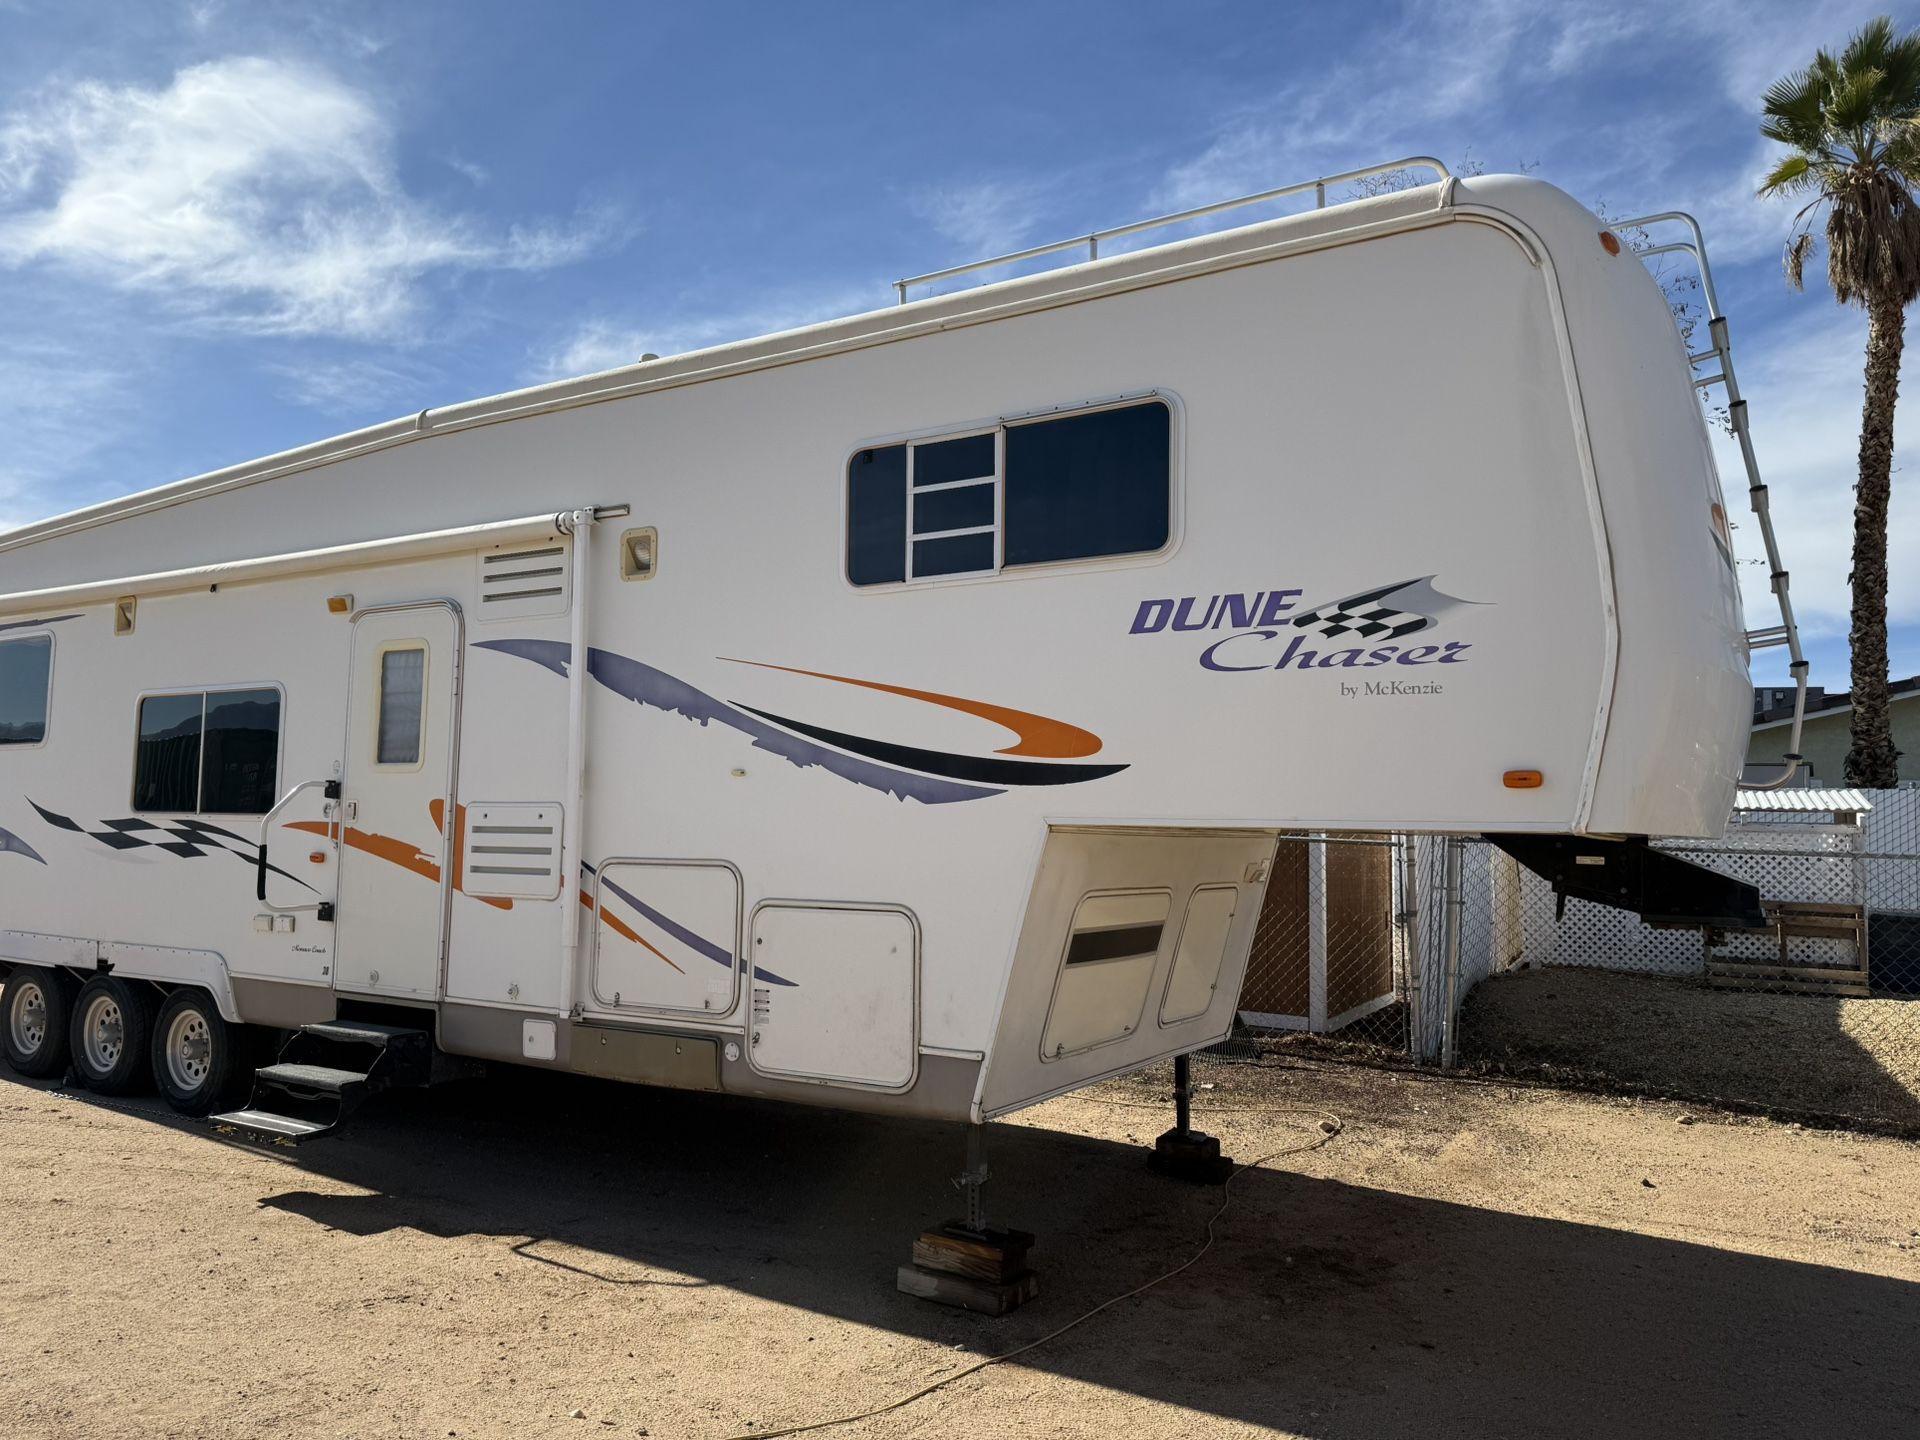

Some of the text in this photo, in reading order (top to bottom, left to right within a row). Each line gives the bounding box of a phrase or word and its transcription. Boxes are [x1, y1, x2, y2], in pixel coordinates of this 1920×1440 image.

[1129, 589, 1303, 634] DUNE
[1199, 631, 1473, 672] Chaser
[1340, 681, 1443, 699] by McKenzie
